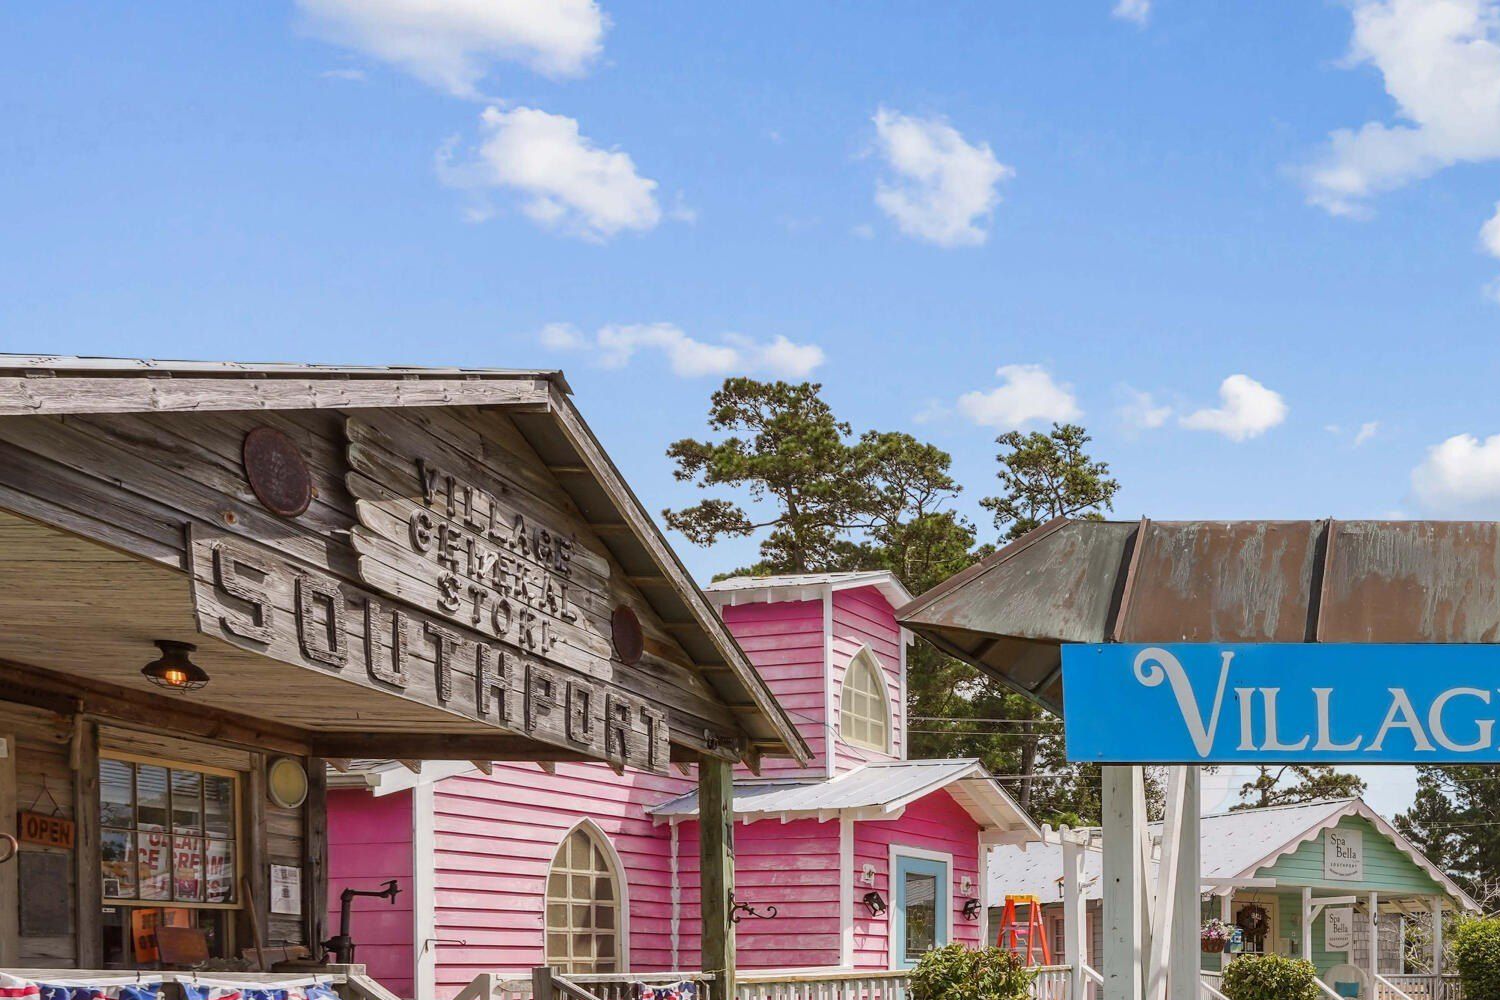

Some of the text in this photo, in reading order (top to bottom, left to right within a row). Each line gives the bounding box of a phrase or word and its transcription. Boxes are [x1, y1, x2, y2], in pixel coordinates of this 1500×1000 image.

[414, 457, 573, 577] VILLAGE
[408, 508, 578, 623] GENERAL
[212, 540, 669, 772] SOUTHPORT
[27, 816, 71, 845] OPEN
[1330, 833, 1346, 848] Spa
[173, 852, 225, 876] REM
[1336, 846, 1357, 859] Bella
[1329, 913, 1341, 924] Spa
[1333, 923, 1349, 933] Bella
